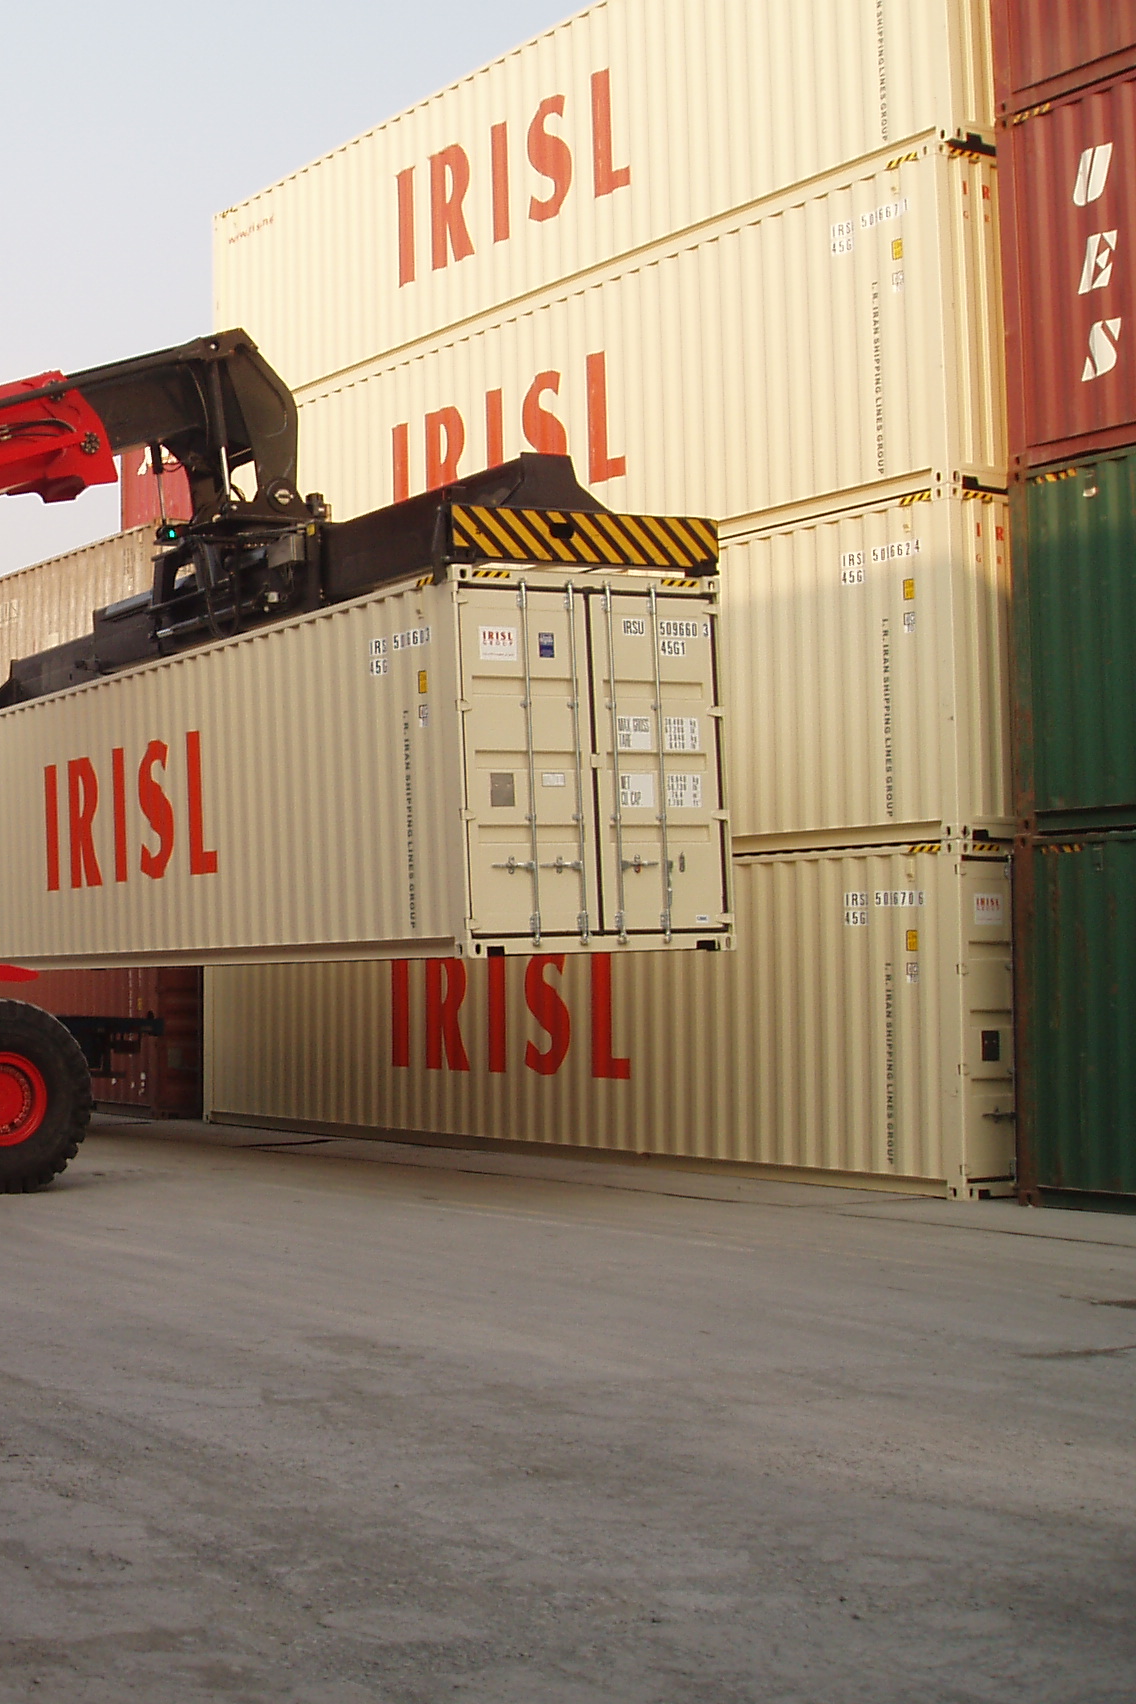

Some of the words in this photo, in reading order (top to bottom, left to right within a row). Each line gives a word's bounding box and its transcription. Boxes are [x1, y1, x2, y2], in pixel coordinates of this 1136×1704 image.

[876, 11, 884, 65] SHIPPING
[878, 66, 886, 100] LINES
[880, 103, 888, 141] GROUP
[395, 67, 631, 289] IRISL
[832, 222, 854, 237] IRS
[392, 350, 626, 503] IRISL
[842, 552, 864, 567] IRS
[482, 631, 512, 640] IRISL
[623, 620, 644, 635] IRSU
[660, 622, 697, 636] 509660
[703, 623, 708, 636] 3
[661, 640, 686, 654] 45G1
[884, 737, 892, 773] LINES
[44, 730, 218, 892] IRISL
[405, 775, 413, 838] SHIPPING
[846, 893, 868, 907] IRS
[391, 952, 631, 1080] IRISL
[886, 1022, 894, 1080] SHIPPING
[886, 1083, 894, 1119] LINES
